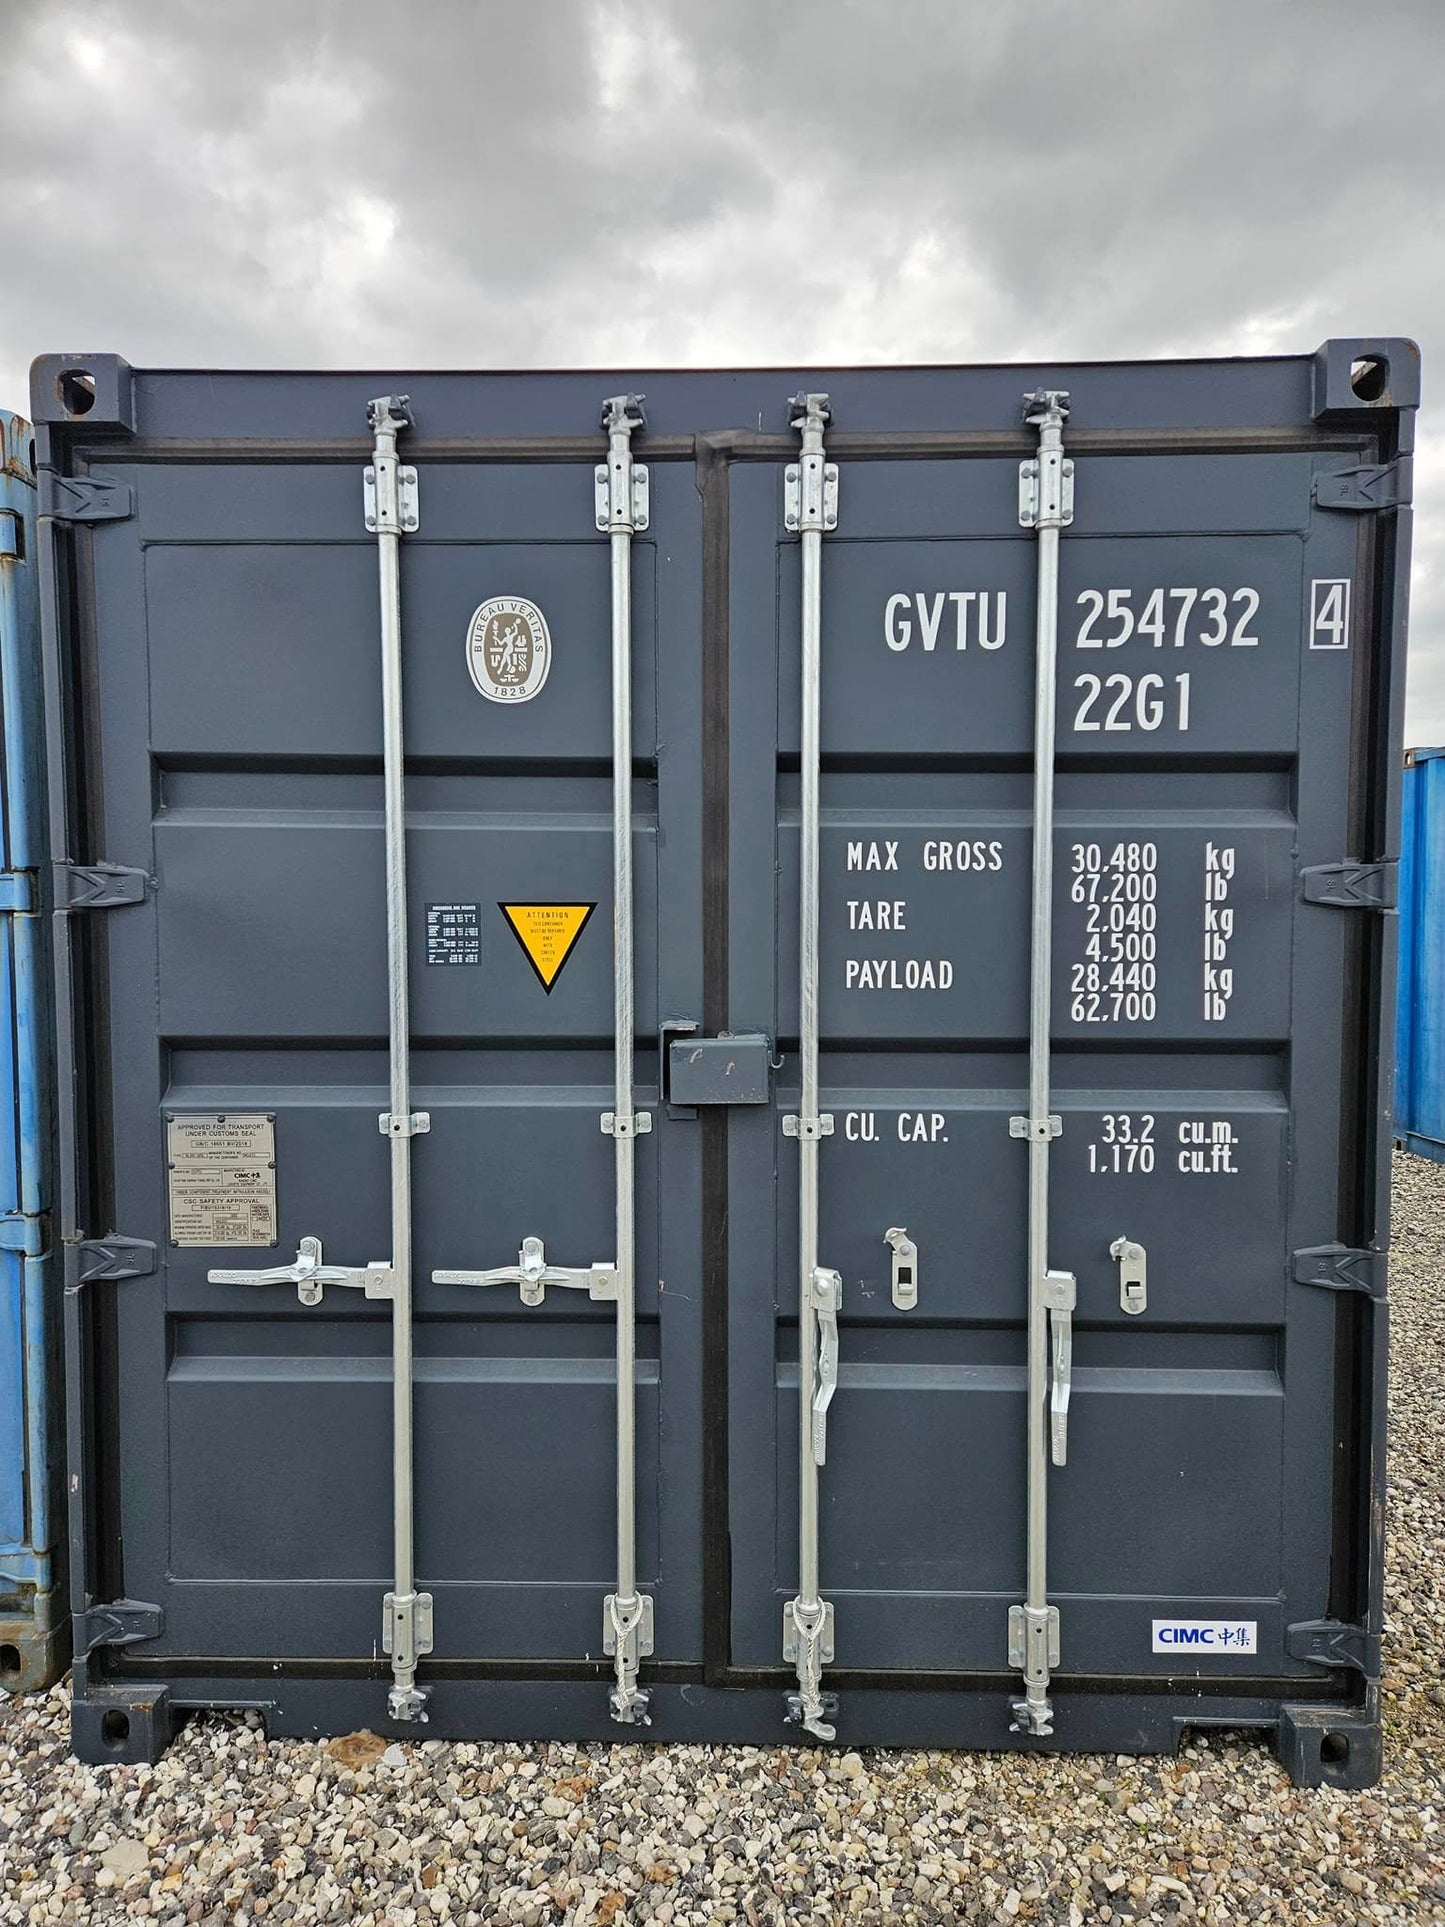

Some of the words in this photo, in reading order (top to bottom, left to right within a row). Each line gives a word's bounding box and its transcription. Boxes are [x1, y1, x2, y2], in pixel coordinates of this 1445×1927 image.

[474, 603, 505, 653] BUREAU
[510, 603, 544, 653] VERITAS
[885, 592, 1006, 651] GVTU
[1076, 587, 1260, 648] 254732
[1315, 585, 1344, 644] 4
[494, 686, 526, 697] 1828
[1074, 673, 1190, 731] 22G1
[847, 841, 899, 871] MAX
[923, 841, 1003, 871] GROSS
[1071, 843, 1157, 873] 30,480
[1205, 842, 1235, 880] kg
[1071, 873, 1157, 903] 67,200
[1205, 872, 1228, 901] lb
[846, 901, 906, 930] TARE
[1085, 903, 1157, 933] 2,040
[1204, 903, 1234, 940] kg
[1085, 933, 1156, 963] 4,500
[1204, 932, 1227, 961] lb
[846, 960, 953, 989] PAYLOAD
[1071, 963, 1156, 993] 28,440
[1204, 962, 1233, 1000] kg
[1071, 992, 1156, 1022] 62,700
[1204, 991, 1226, 1021] lb
[845, 1113, 880, 1142] CU.
[897, 1113, 949, 1143] CAP.
[1101, 1114, 1155, 1144] 33.2
[1178, 1121, 1239, 1144] cu.m.
[1088, 1144, 1155, 1173] 1,170
[1178, 1144, 1239, 1173] cu.ft.
[1158, 1628, 1214, 1644] CIMC
[1217, 1627, 1251, 1647] 中集
